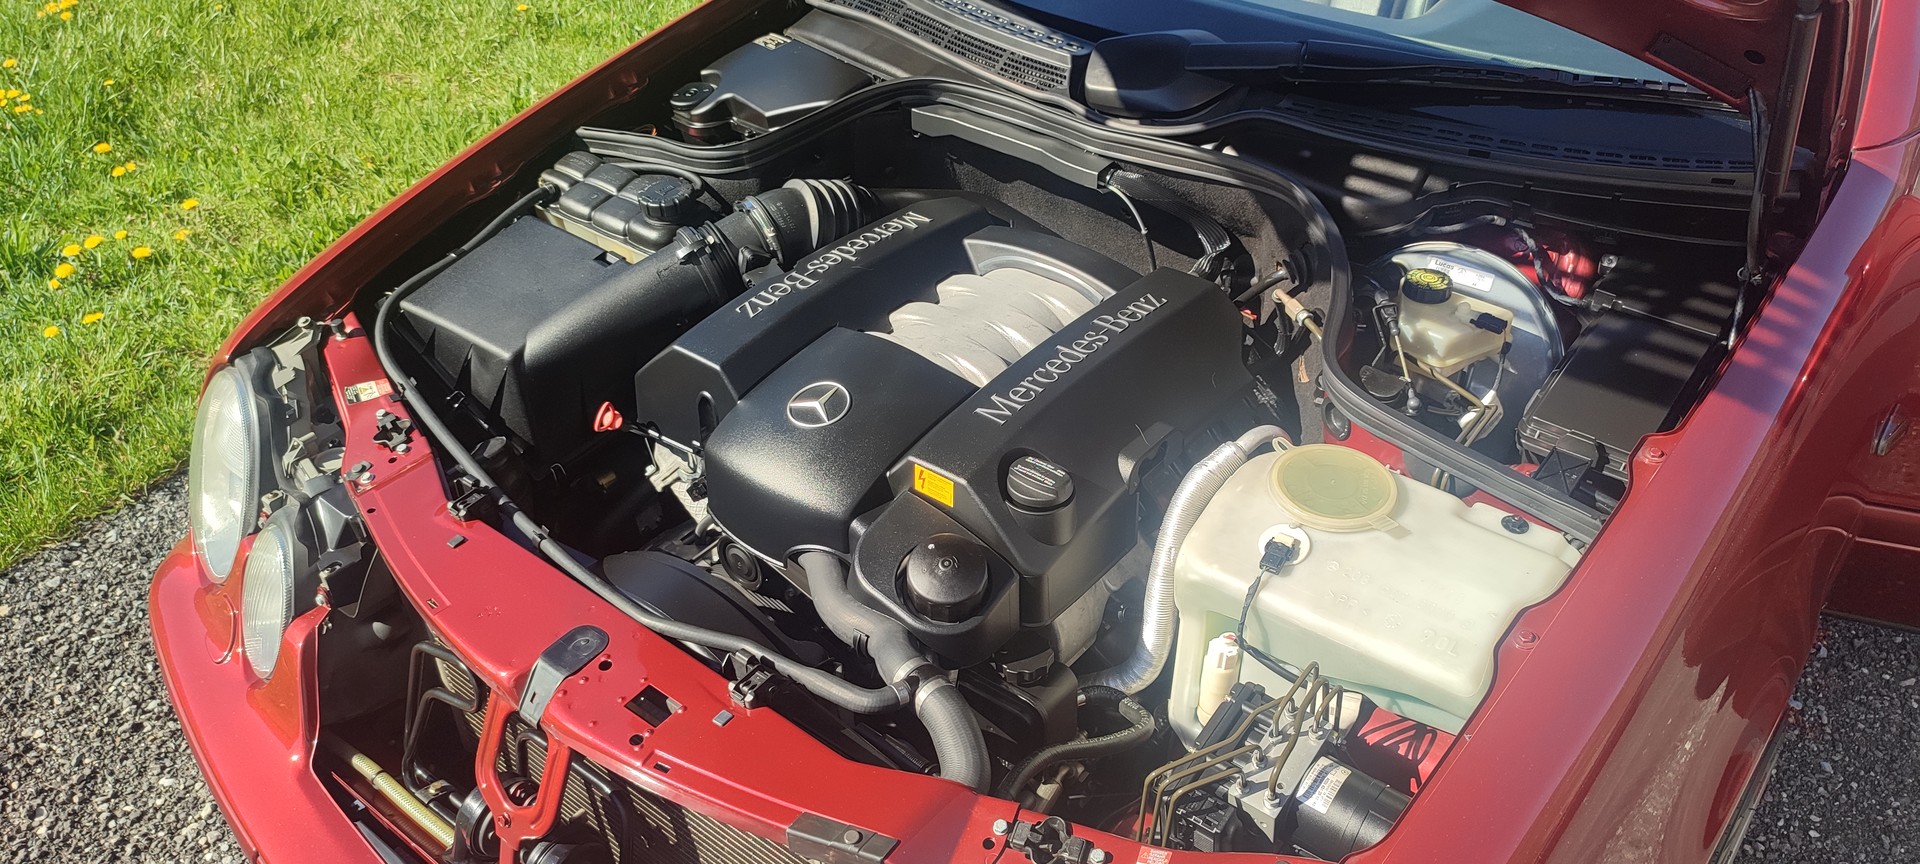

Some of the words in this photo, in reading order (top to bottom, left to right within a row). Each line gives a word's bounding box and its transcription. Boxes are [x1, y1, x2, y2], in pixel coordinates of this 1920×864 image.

[735, 210, 934, 319] Mercedes-Benz
[1434, 259, 1455, 271] Lucas
[972, 293, 1168, 427] Mercedes-Benz
